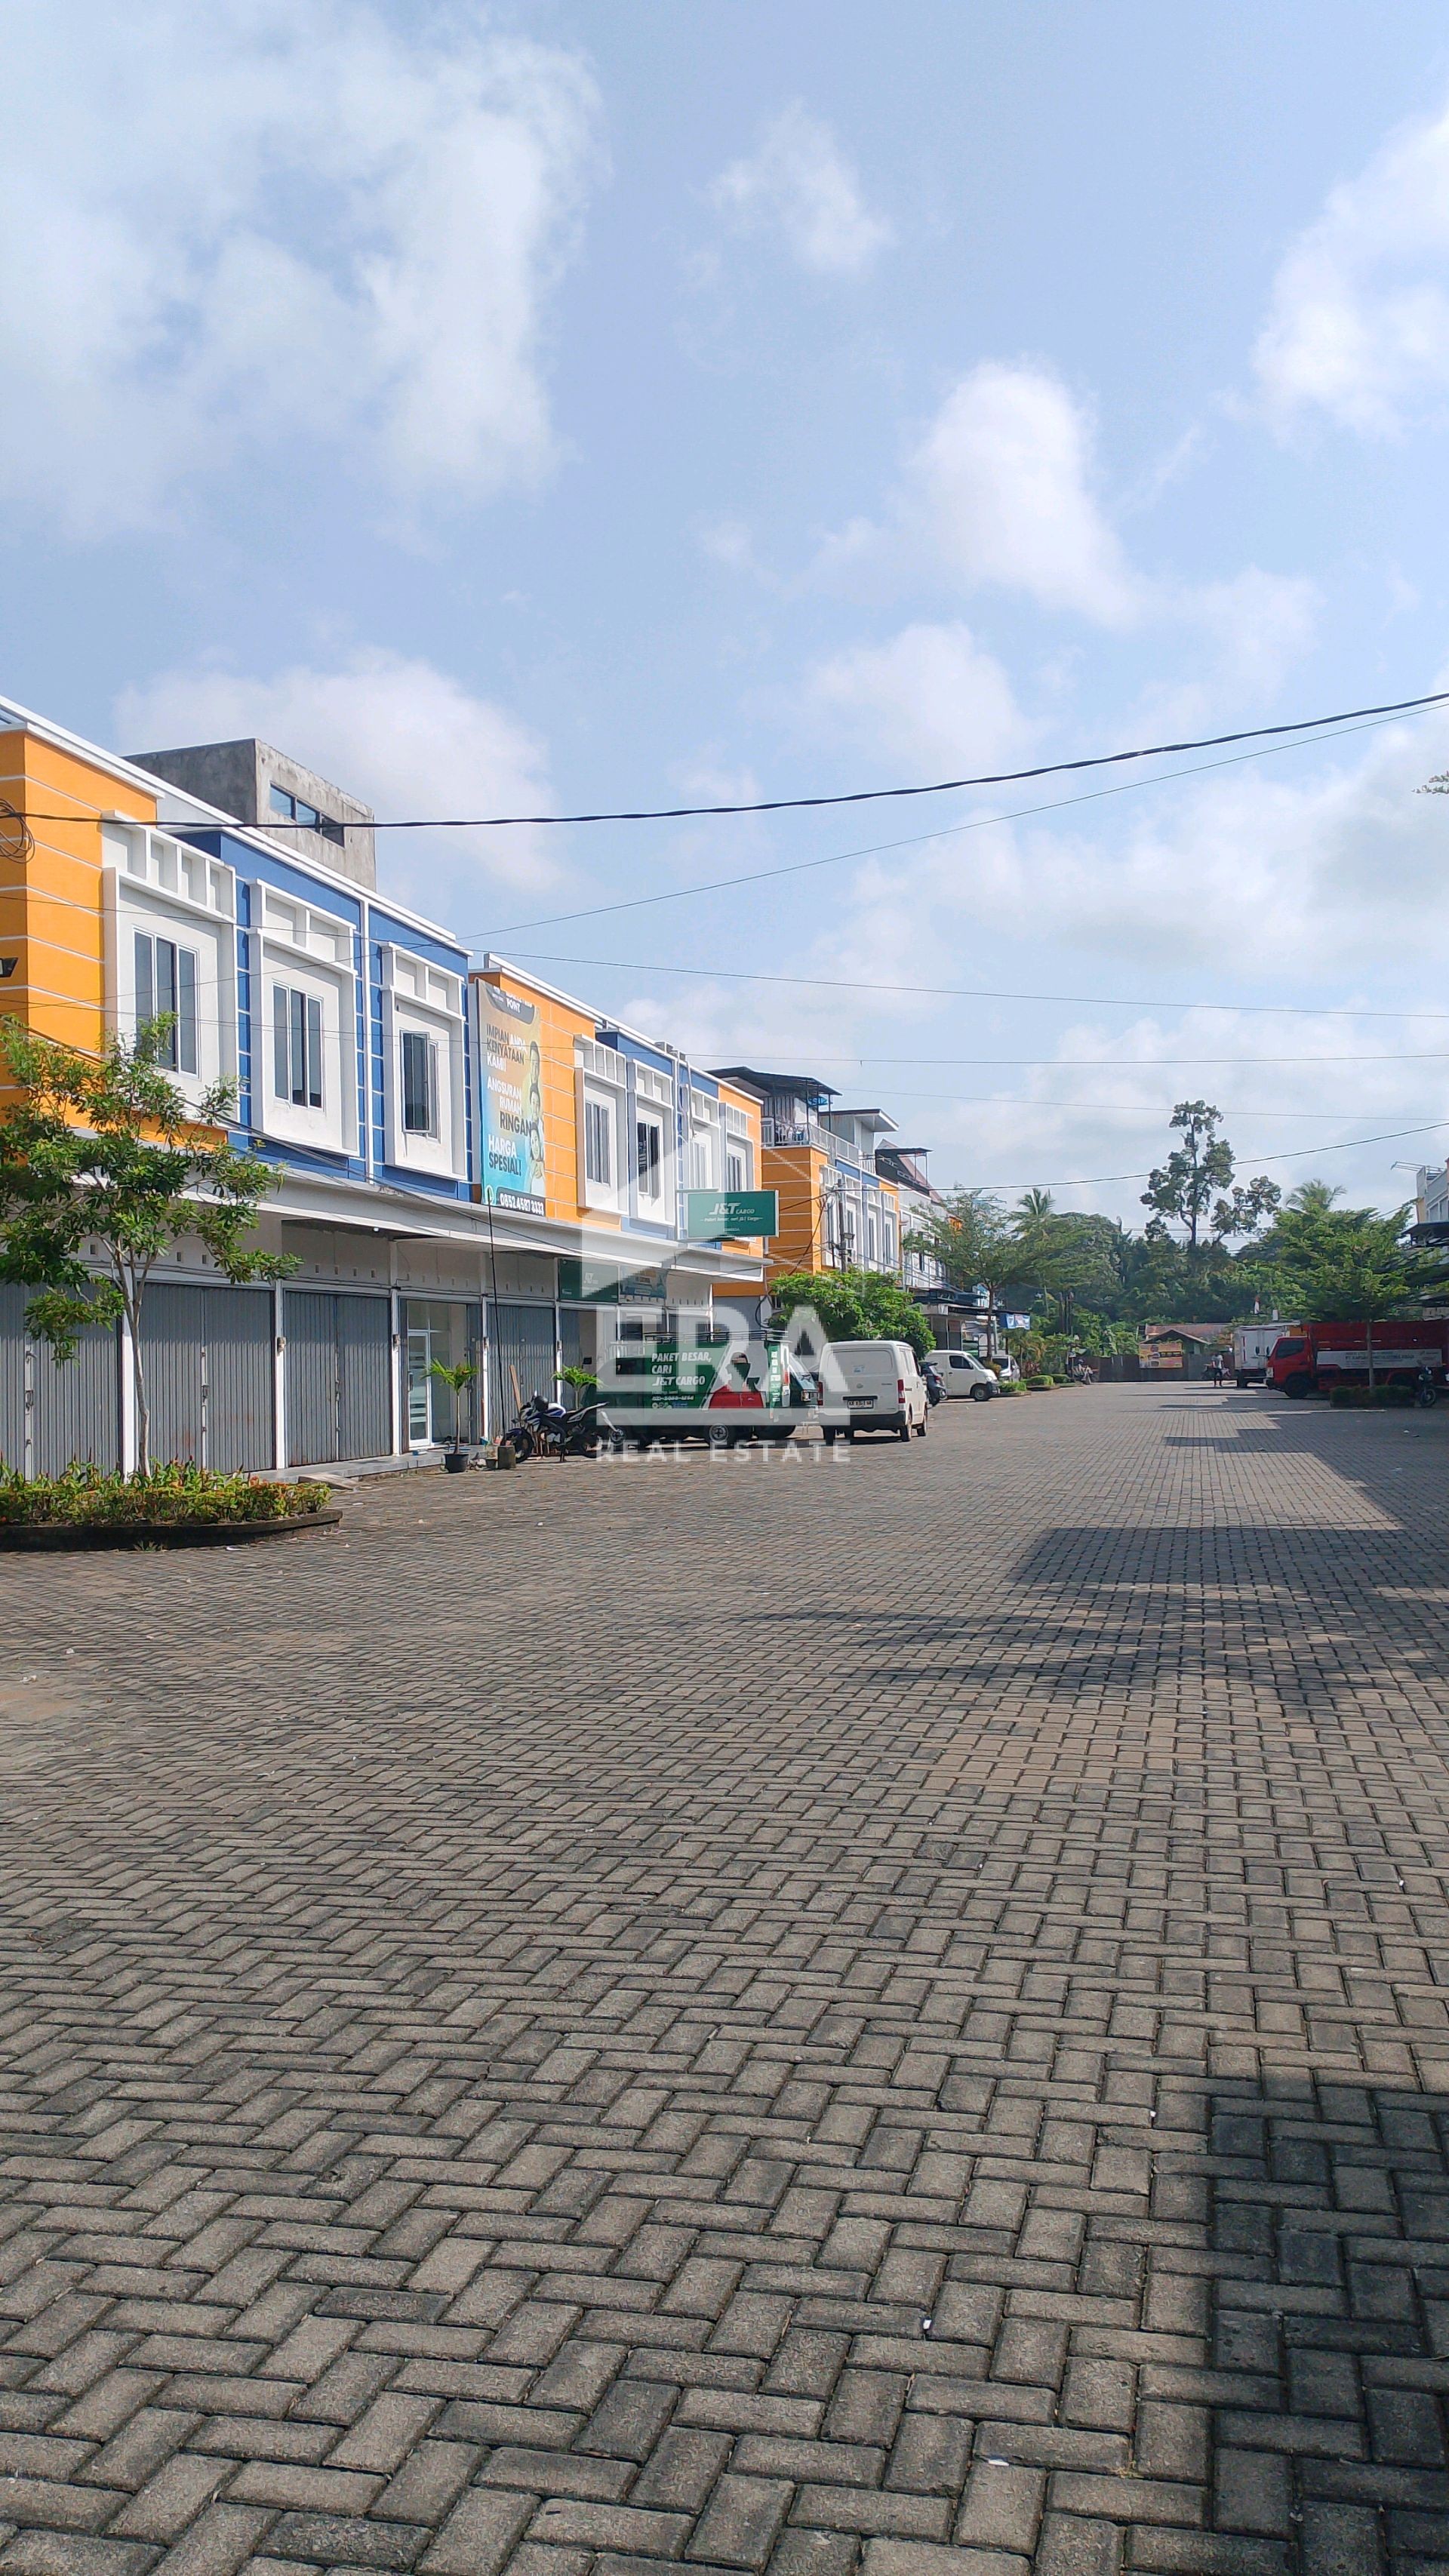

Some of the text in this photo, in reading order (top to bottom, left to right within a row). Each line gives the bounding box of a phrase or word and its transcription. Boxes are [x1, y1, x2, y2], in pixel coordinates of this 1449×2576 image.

[486, 1023, 528, 1056] IMPIAN ANDA
[487, 1038, 525, 1065] KENYATAAN
[487, 1076, 521, 1100] ANGSURAN
[500, 1095, 522, 1116] RUMAH
[500, 1110, 532, 1137] RINGAN
[488, 1134, 517, 1158] HARGA
[488, 1152, 521, 1177] SPESIAL!
[709, 1202, 741, 1215] J&T
[651, 1352, 712, 1362] PAKET BESAR,
[651, 1365, 672, 1374] CARI
[652, 1376, 706, 1386] J&T CARGO
